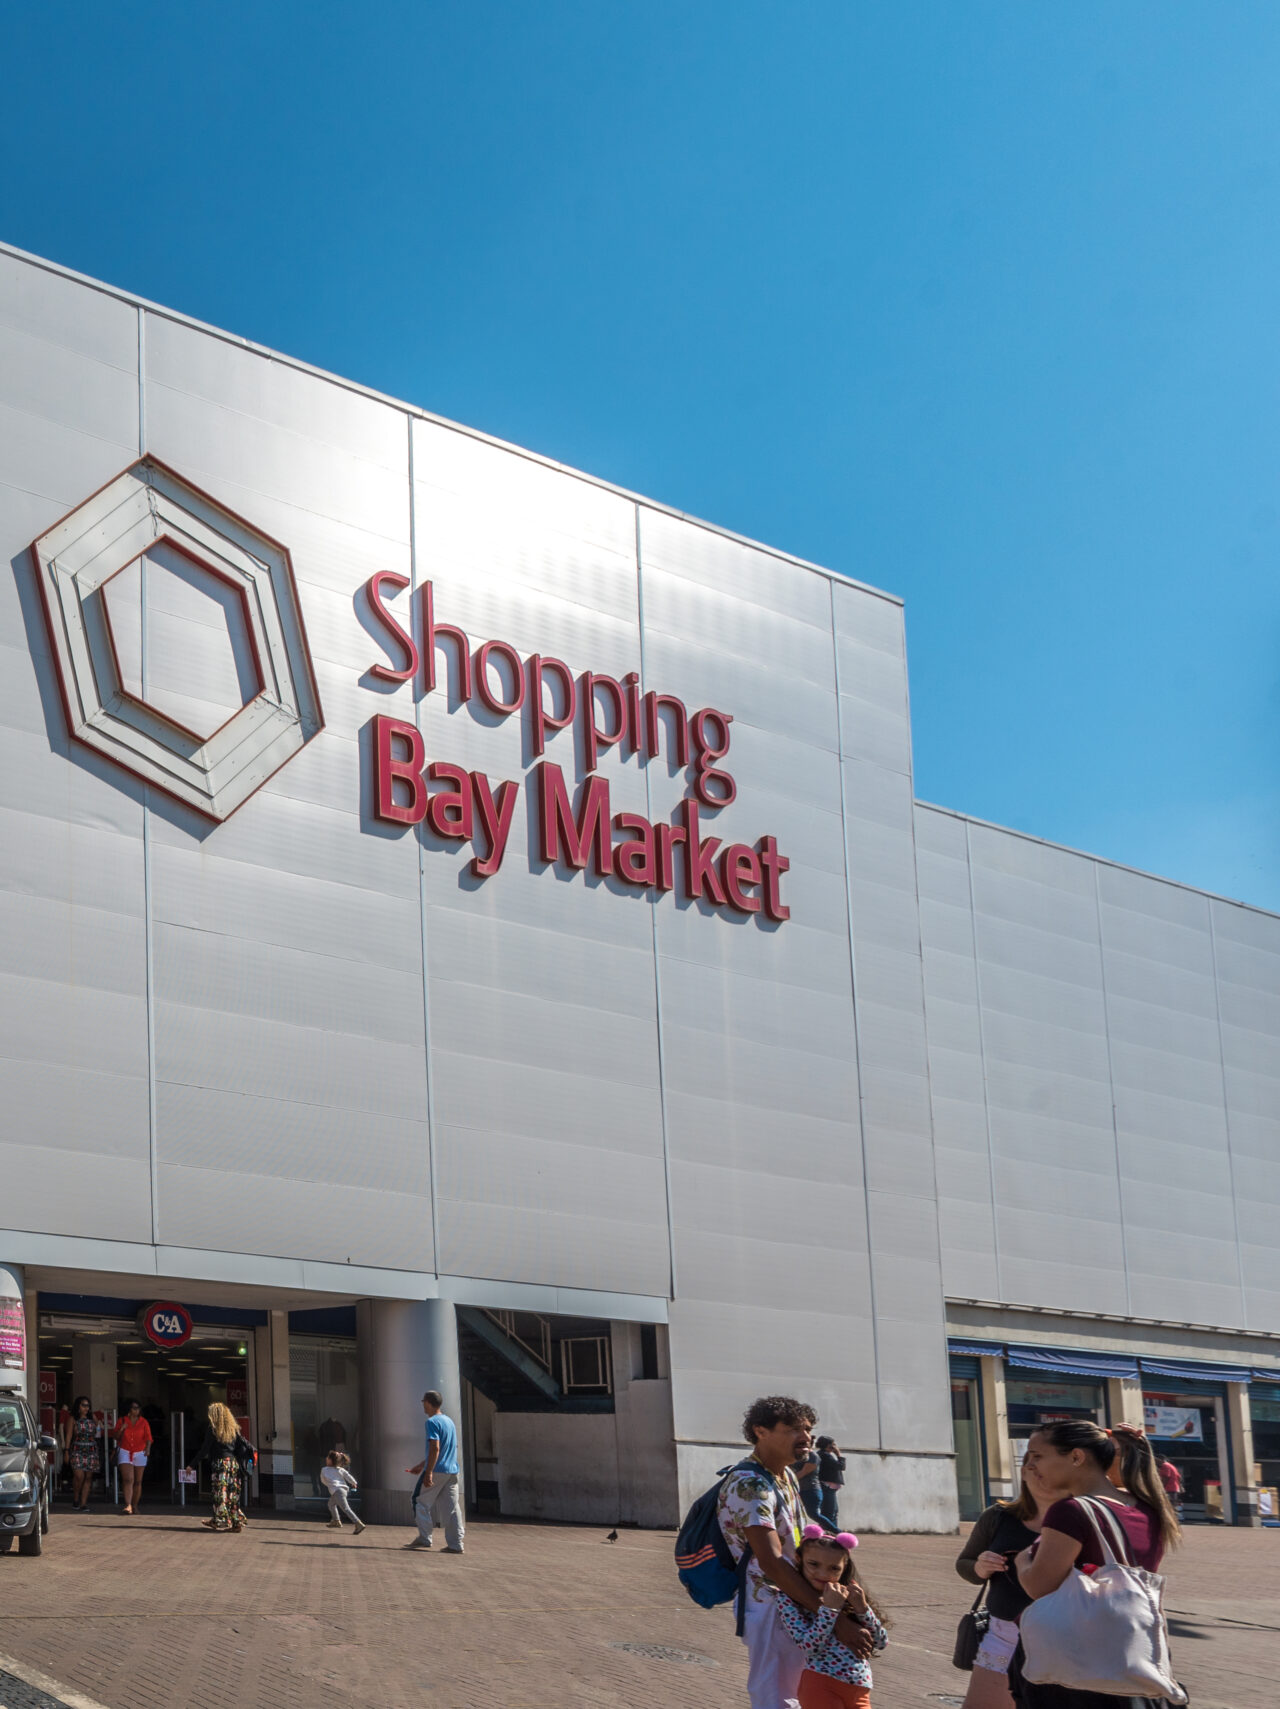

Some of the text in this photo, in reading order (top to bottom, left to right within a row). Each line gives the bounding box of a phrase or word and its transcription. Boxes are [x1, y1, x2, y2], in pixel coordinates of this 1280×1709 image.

[366, 570, 737, 807] Shopping
[372, 713, 791, 922] Bay Market
[152, 1313, 183, 1334] C&A
